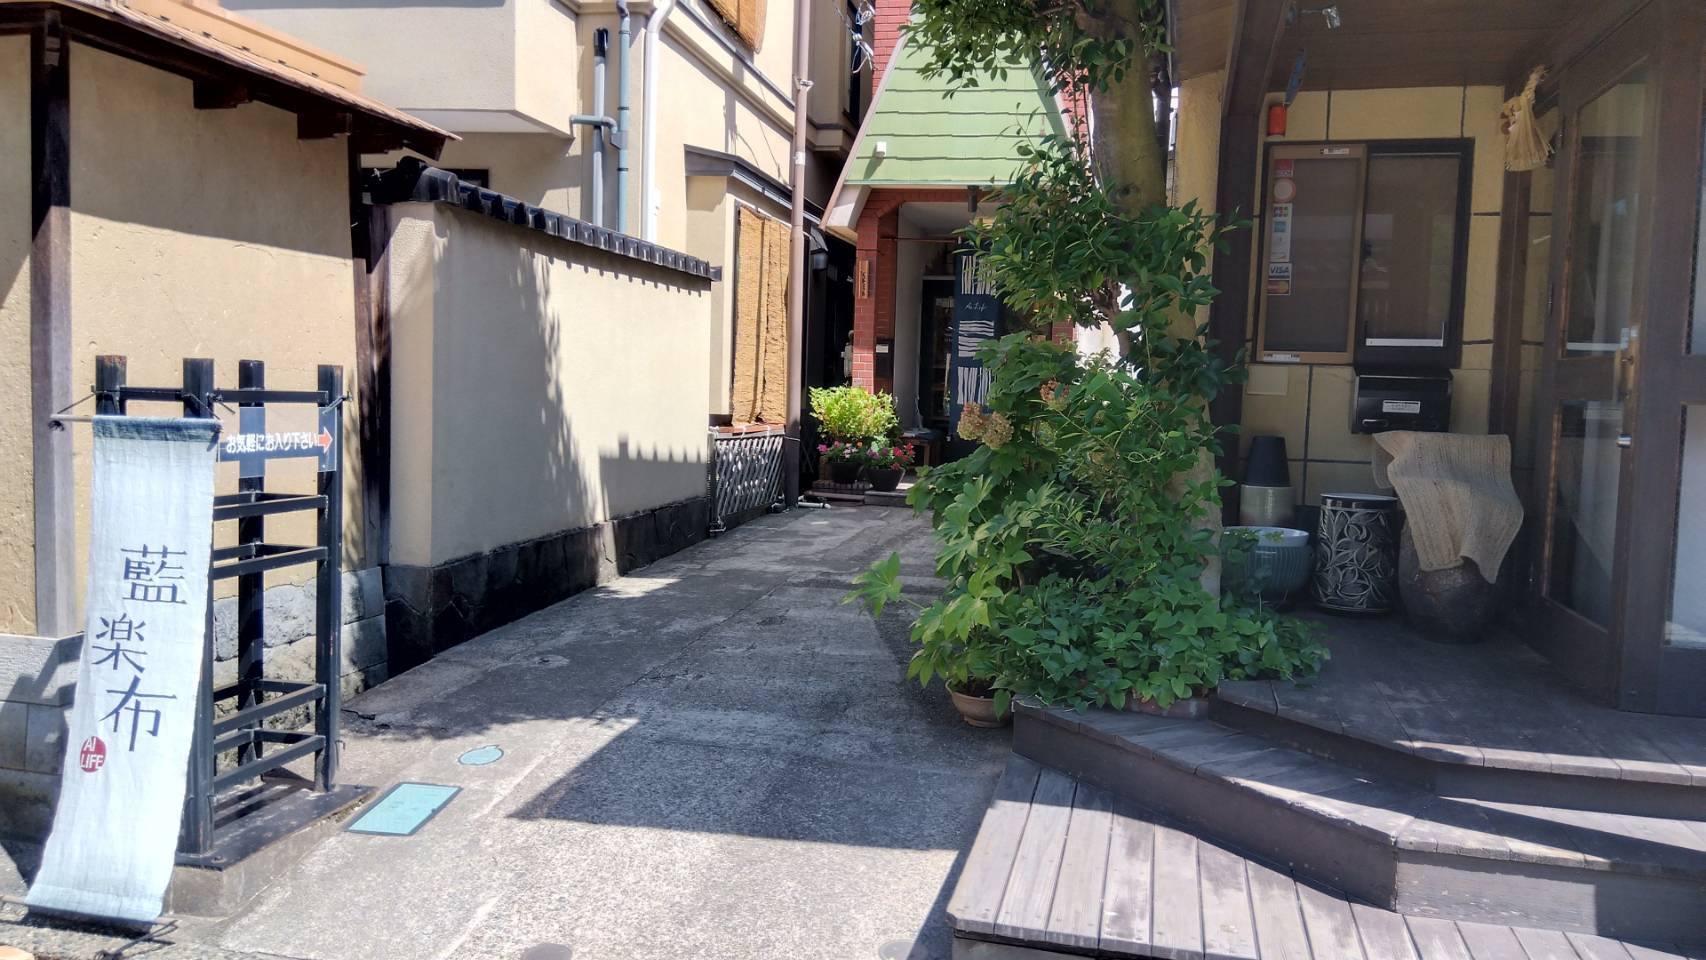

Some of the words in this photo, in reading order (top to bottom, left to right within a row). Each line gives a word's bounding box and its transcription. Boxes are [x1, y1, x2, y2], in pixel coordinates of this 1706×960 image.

[1270, 265, 1289, 274] VISA
[226, 432, 318, 454] お気軽にお入り下さい
[91, 544, 187, 752] 藍楽布
[83, 737, 97, 752] AI
[80, 754, 104, 770] LIFE
